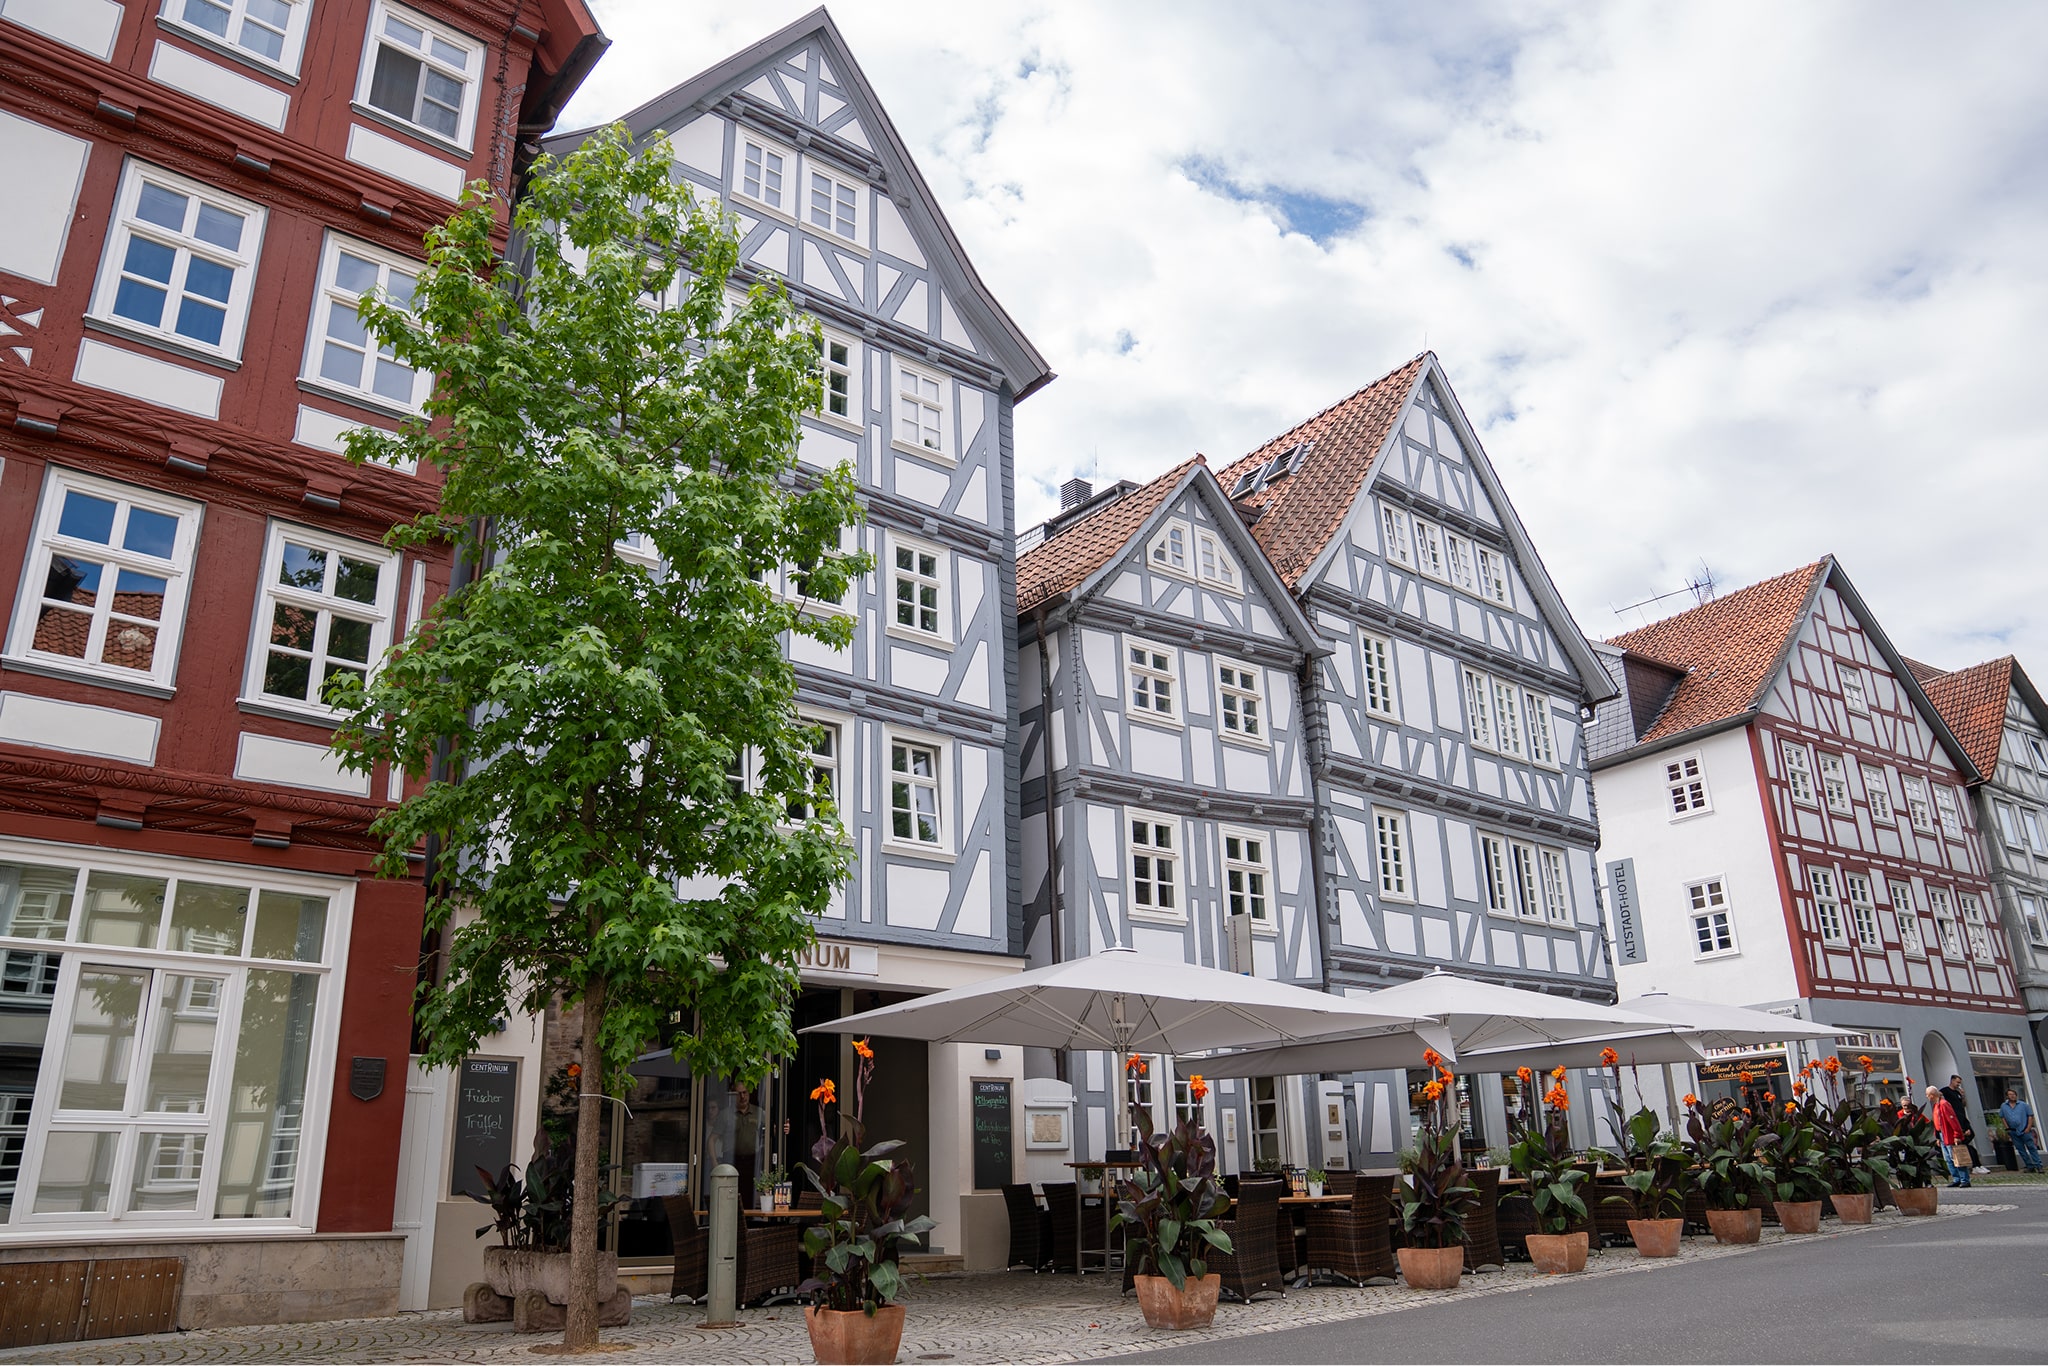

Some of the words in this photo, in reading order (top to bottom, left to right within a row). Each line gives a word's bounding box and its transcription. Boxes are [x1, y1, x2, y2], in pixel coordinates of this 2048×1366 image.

[1615, 863, 1637, 959] ALTSTADT-HOTEL
[464, 1088, 504, 1103] Frischer
[464, 1113, 504, 1135] Trüffel
